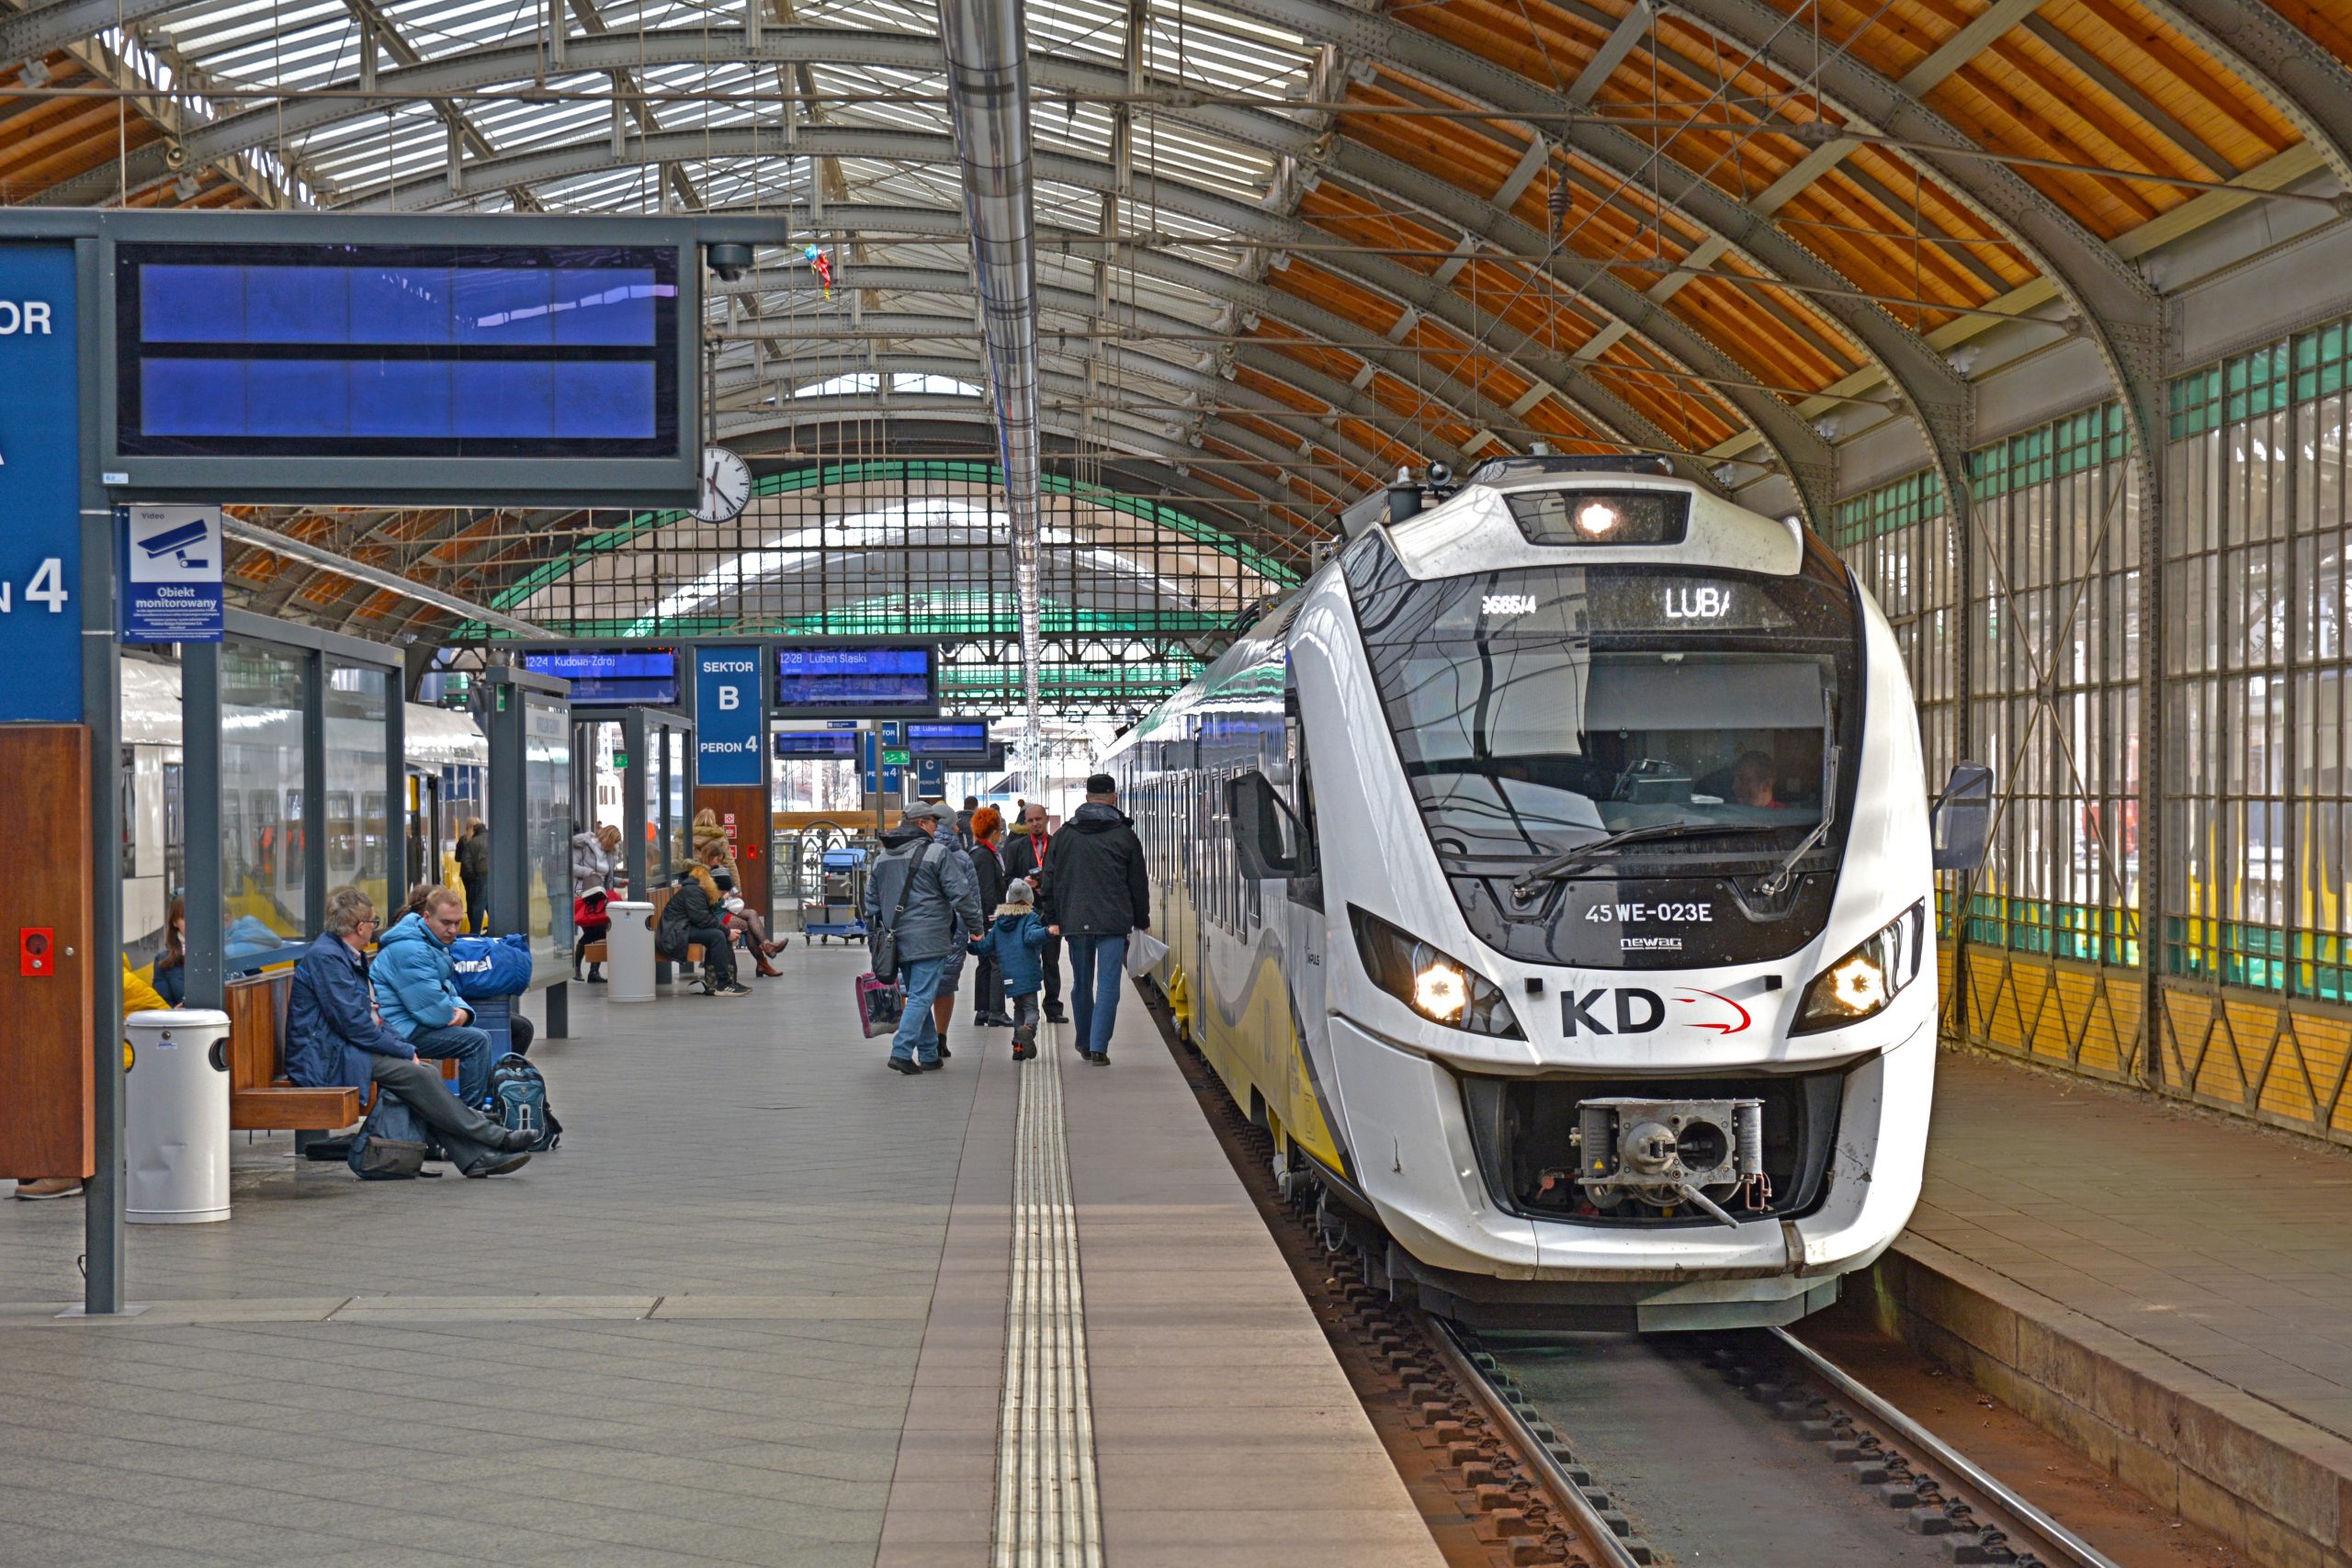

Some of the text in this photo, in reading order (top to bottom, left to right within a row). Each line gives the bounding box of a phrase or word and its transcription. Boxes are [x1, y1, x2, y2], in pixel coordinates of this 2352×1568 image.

[157, 587, 195, 597] Obiekt
[136, 599, 217, 609] monitorowany
[703, 662, 753, 672] SEKTOR
[719, 685, 740, 710] B
[700, 735, 758, 752] PERON 4
[925, 760, 934, 770] C
[890, 768, 897, 777] 4
[452, 955, 493, 973] mmel
[1560, 987, 1666, 1038] KD
